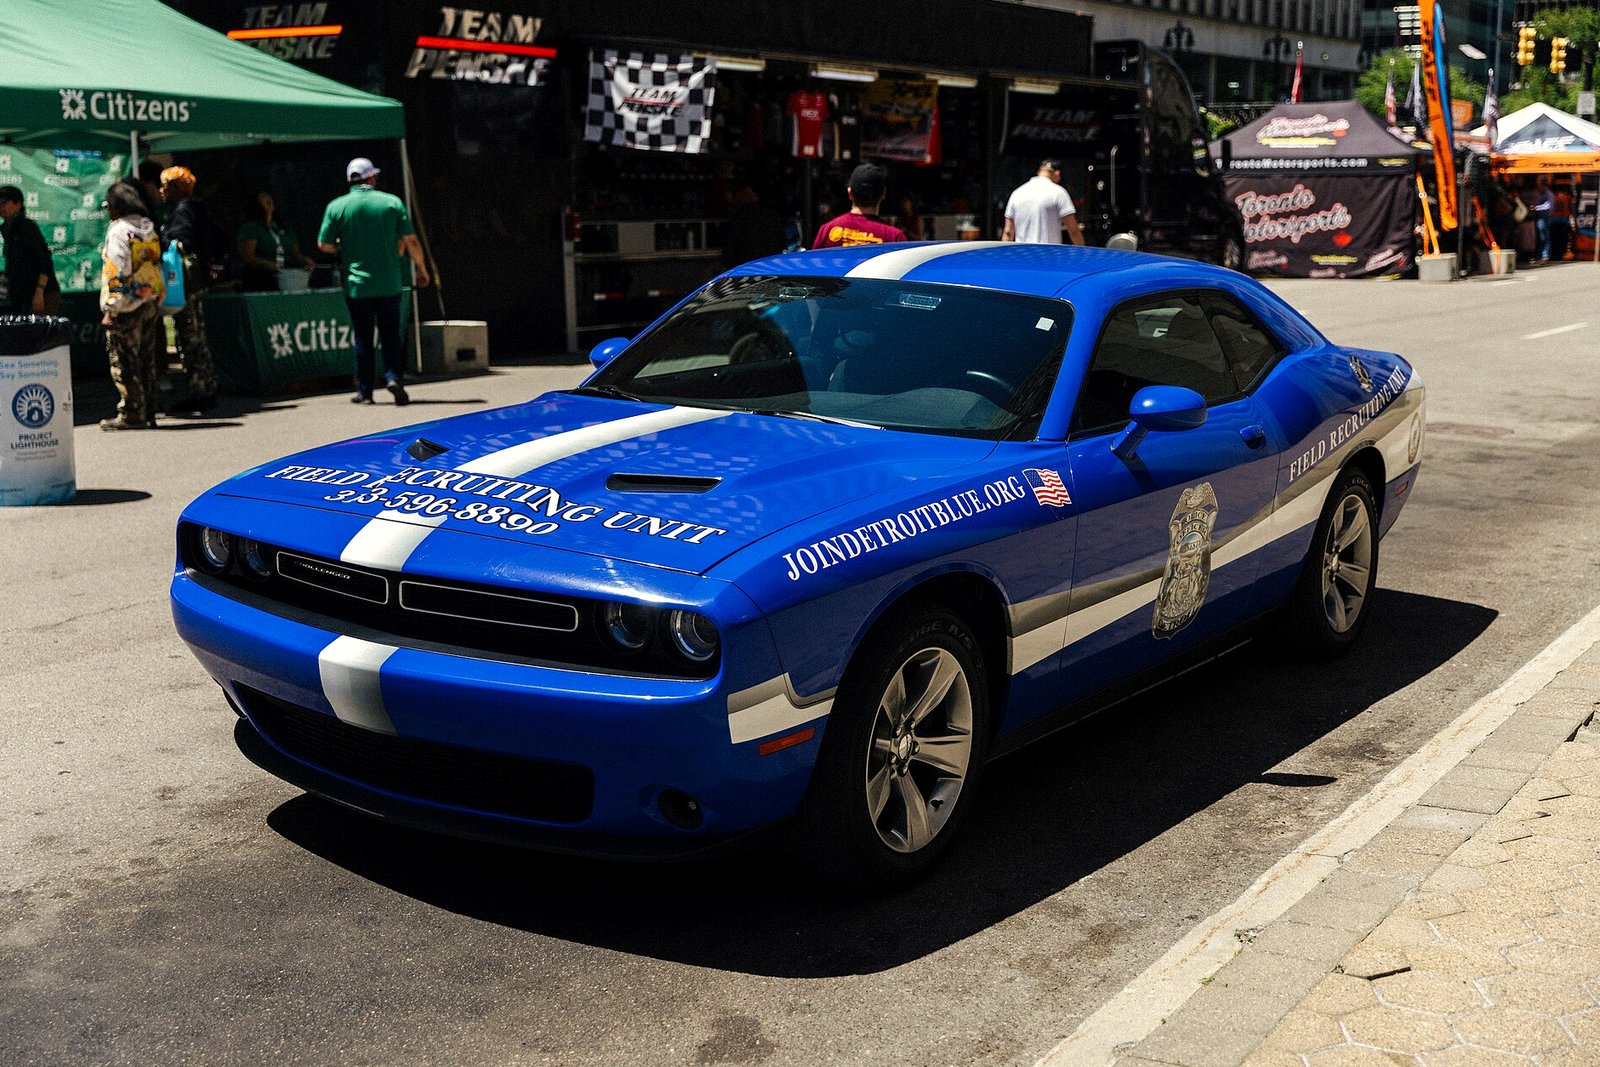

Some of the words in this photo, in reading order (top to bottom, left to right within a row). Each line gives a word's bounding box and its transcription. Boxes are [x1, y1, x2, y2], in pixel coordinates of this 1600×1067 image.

[245, 3, 328, 28] TEAM
[437, 6, 544, 43] TEAM
[247, 36, 340, 60] NSKE
[404, 47, 551, 87] PENSKE
[90, 91, 191, 123] Citizens
[631, 87, 679, 105] TEAM
[618, 101, 681, 118] PENSKE
[1031, 107, 1097, 122] TEAM
[1009, 122, 1101, 142] PENSKE
[1215, 158, 1368, 170] TrontoMotorsports.com
[1235, 183, 1316, 217] Toronto
[1244, 203, 1352, 243] otorsports
[18, 359, 58, 369] Something
[18, 369, 58, 379] Something
[1289, 440, 1326, 482] FIELD
[1329, 384, 1392, 451] RECRUITING
[1387, 365, 1407, 394] UNIT
[11, 439, 59, 450] LIGHTHOUSE
[18, 431, 53, 441] PROJECT
[264, 465, 371, 485] FIELD
[602, 511, 727, 544] UNIT
[782, 475, 1026, 581] JOINDETROITBLUE.ORG
[293, 560, 351, 579] CHALLENGER
